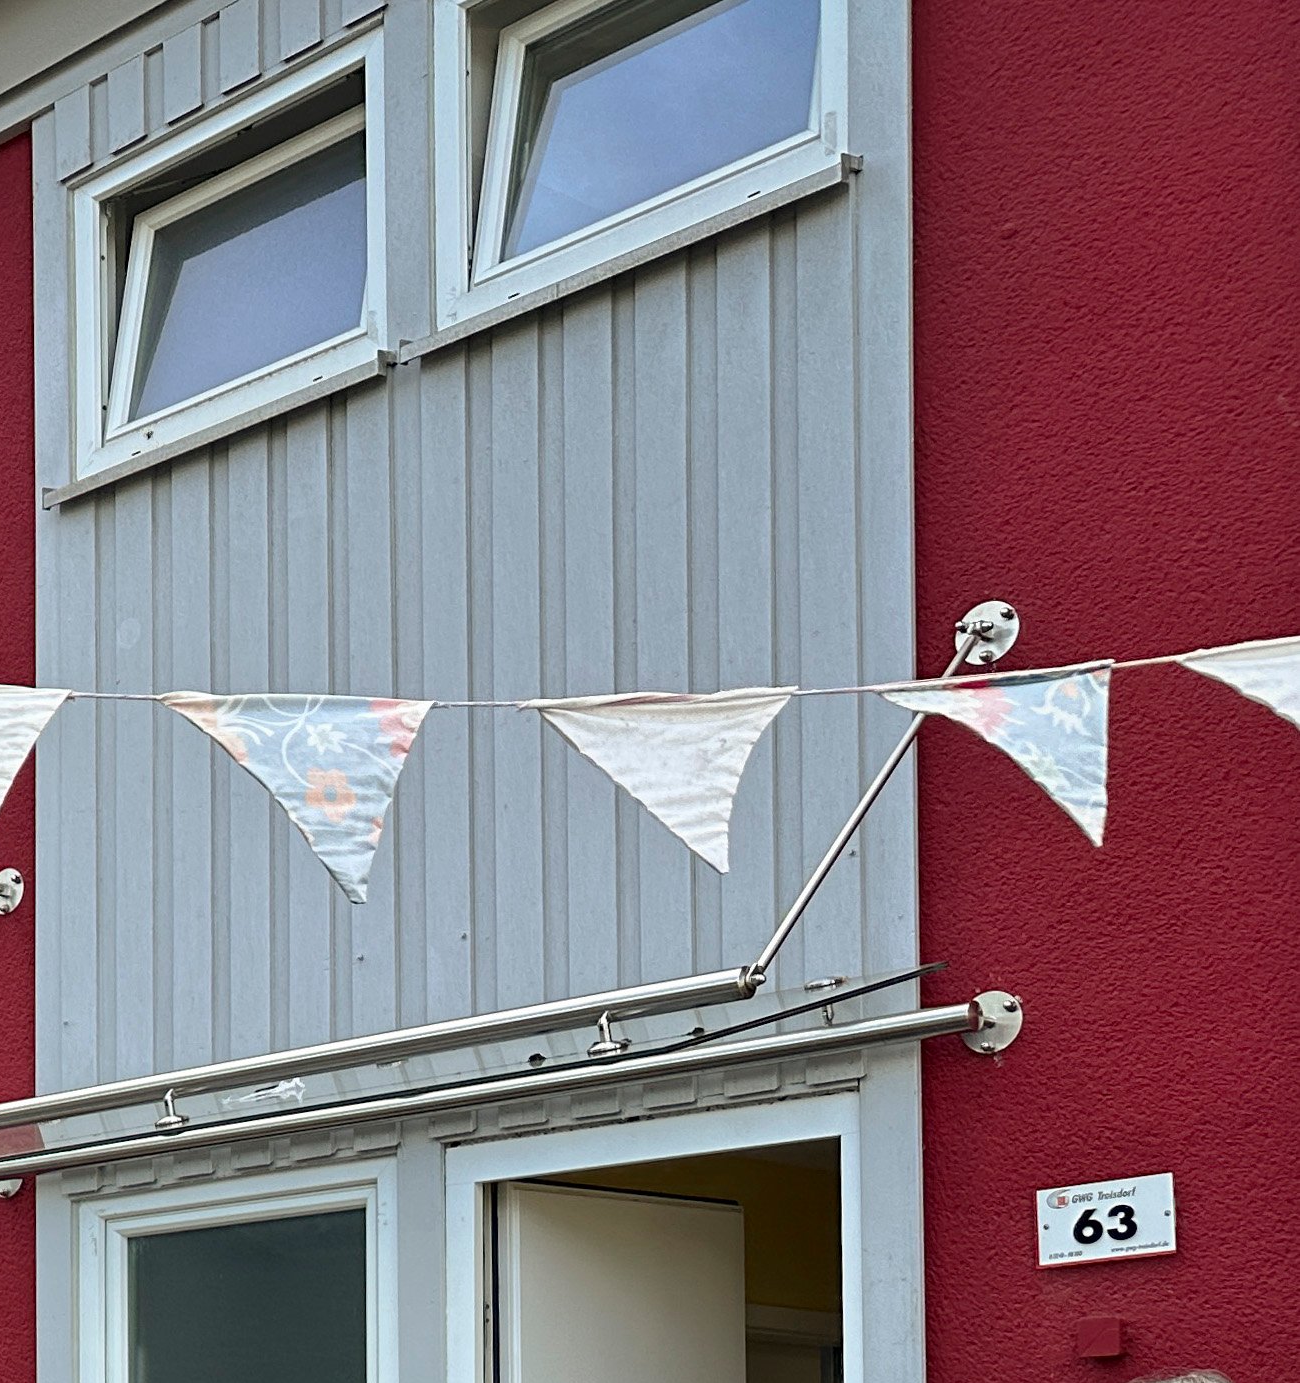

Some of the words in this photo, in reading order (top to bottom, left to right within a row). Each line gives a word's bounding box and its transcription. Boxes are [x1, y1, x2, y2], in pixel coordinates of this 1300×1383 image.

[1071, 1192, 1093, 1204] GWG
[1097, 1186, 1136, 1201] Troisdorf
[1073, 1204, 1138, 1245] 63
